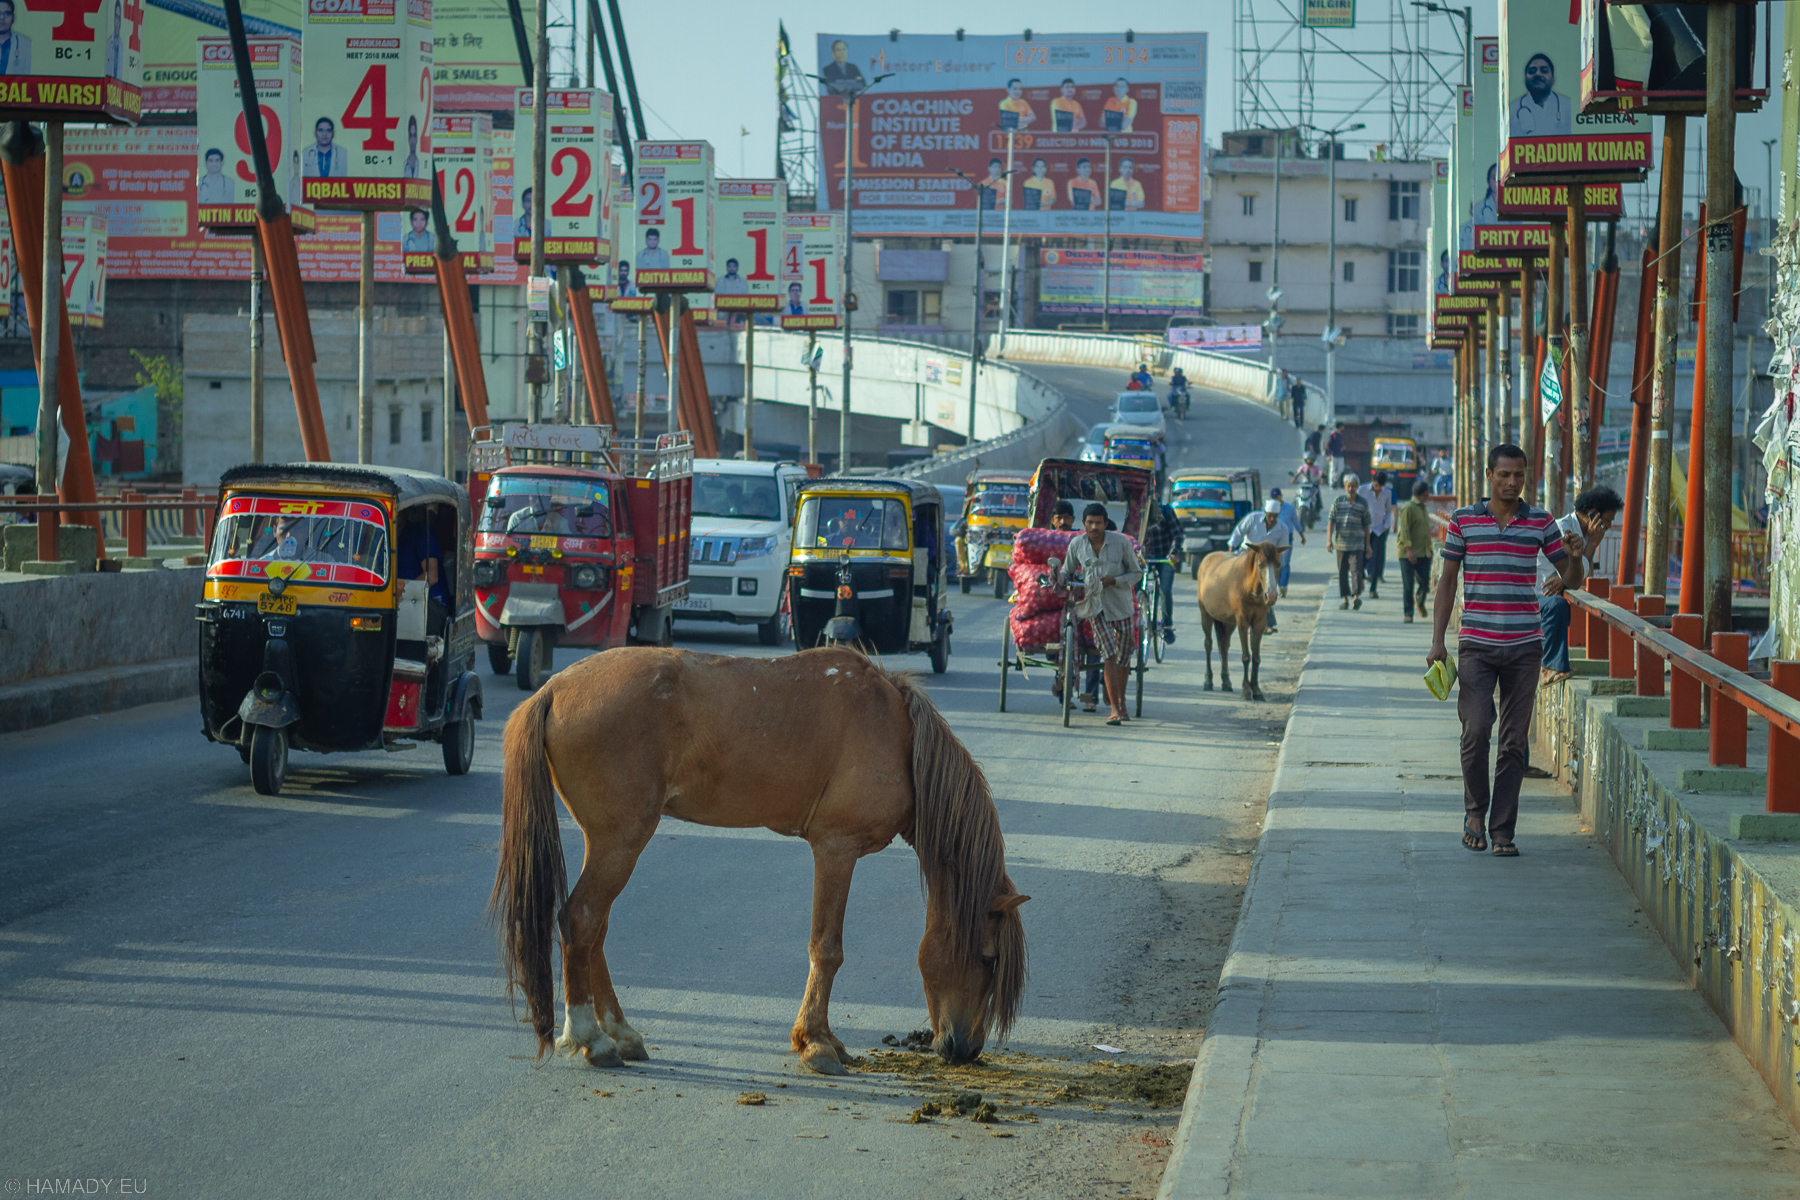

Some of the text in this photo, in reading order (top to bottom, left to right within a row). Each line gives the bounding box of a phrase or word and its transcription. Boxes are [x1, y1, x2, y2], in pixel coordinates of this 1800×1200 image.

[310, 0, 362, 12] GOAL
[1308, 0, 1350, 8] NILGIRI
[348, 39, 398, 48] JHARKHAND
[55, 48, 91, 60] BC 1
[205, 46, 233, 60] GO
[1015, 47, 1048, 64] 672
[1104, 47, 1148, 64] 3124
[934, 59, 992, 72] Eduserv
[155, 70, 197, 81] ENOUG
[434, 69, 498, 80] UR SMILES
[37, 83, 101, 106] WARSI
[521, 93, 564, 106] GAL
[340, 64, 400, 151] 4
[871, 99, 973, 115] COACHING
[432, 119, 448, 130] AL
[871, 117, 961, 132] INSTITUTE
[1576, 112, 1639, 124] GENERAL
[134, 128, 151, 136] OF
[1168, 121, 1197, 132] 2018
[124, 143, 142, 152] OF
[234, 104, 282, 183] 9
[871, 135, 980, 150] OF EASTERN
[996, 135, 1032, 149] 139
[1036, 138, 1076, 147] SELECTED
[1078, 139, 1089, 147] IN
[1131, 140, 1153, 148] 2018
[641, 146, 678, 157] GOAL
[1515, 140, 1646, 164] PRADUM KUMAR
[365, 156, 392, 165] BC 1
[871, 152, 924, 168] INDIA
[72, 174, 83, 186] A
[550, 146, 594, 216] 2
[837, 178, 972, 191] ADMISSION STARTED
[306, 182, 401, 200] IQBAL WARSI
[720, 184, 753, 195] GOAL
[1504, 187, 1618, 205] KUMAR ABSHEK
[640, 182, 662, 216] 2
[198, 208, 231, 223] NITIN
[786, 217, 813, 227] GOAL
[568, 222, 579, 230] SC
[672, 197, 704, 255] 1
[1480, 230, 1520, 246] PRITY
[564, 242, 594, 254] KUMAR
[746, 228, 775, 281] 1
[786, 246, 800, 273] 4
[1161, 254, 1199, 262] SCHOOL
[1462, 255, 1502, 270] IQBAL
[62, 254, 84, 300] 7
[638, 271, 705, 284] ADITYA KUMAR
[809, 258, 833, 304] 1
[750, 297, 776, 308] PRASAD
[1438, 297, 1479, 309] AWADHESH
[807, 316, 835, 328] KUMAR
[563, 538, 585, 549] लाभ
[260, 602, 293, 612] 5748
